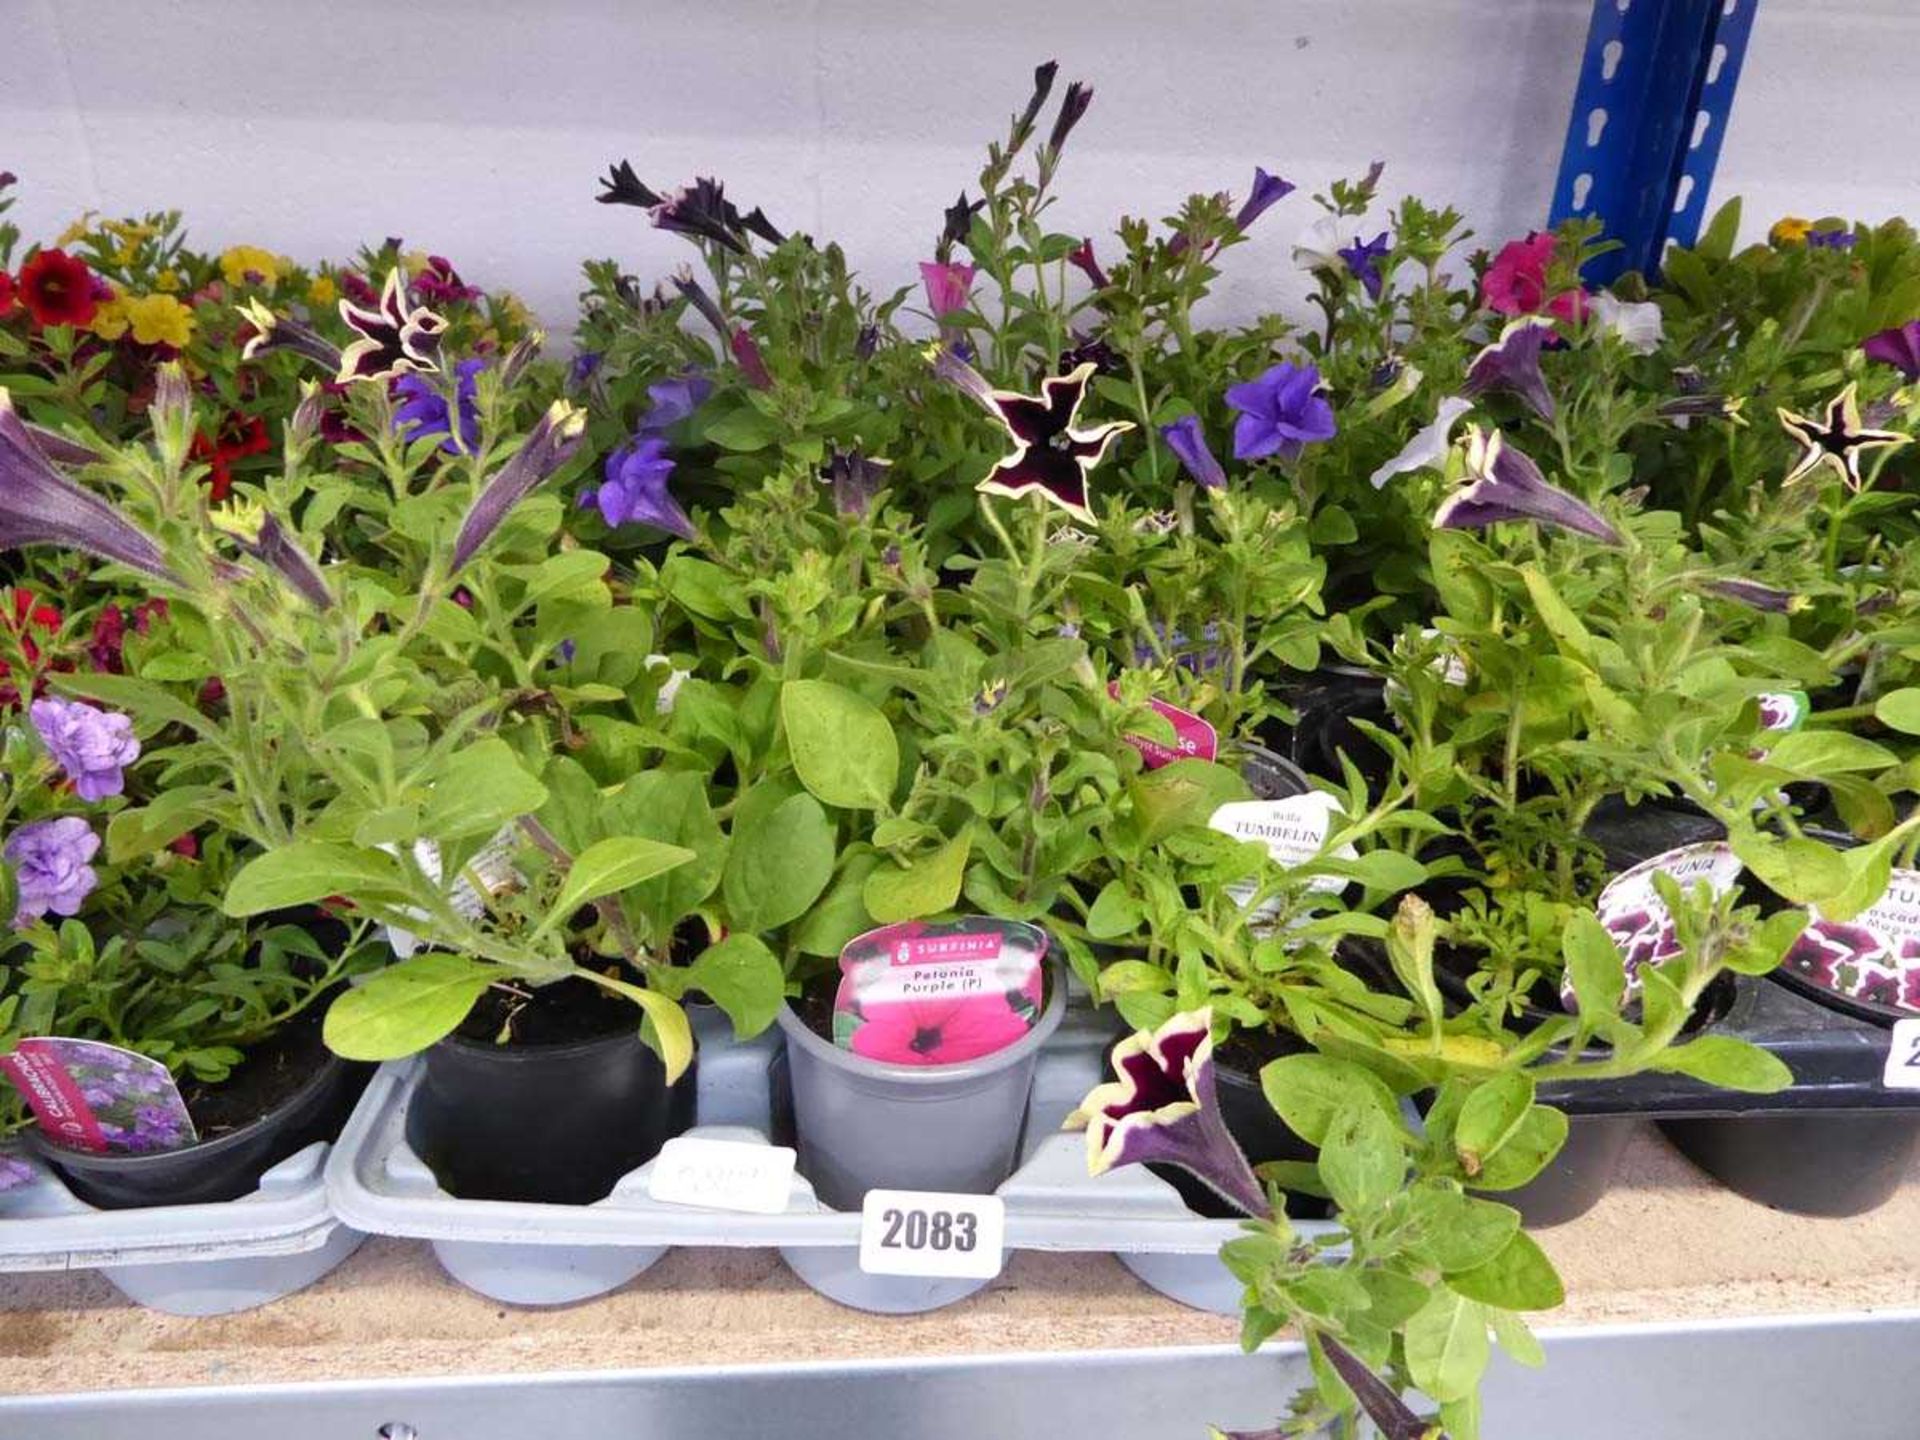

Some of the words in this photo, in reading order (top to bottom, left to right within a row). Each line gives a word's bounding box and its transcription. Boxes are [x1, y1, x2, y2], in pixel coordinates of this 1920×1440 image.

[1236, 821, 1321, 843] TUMBELIN
[1670, 858, 1716, 876] TUNIA
[903, 981, 955, 994] Purple
[962, 977, 983, 992] (P)
[881, 1209, 978, 1252] 2083
